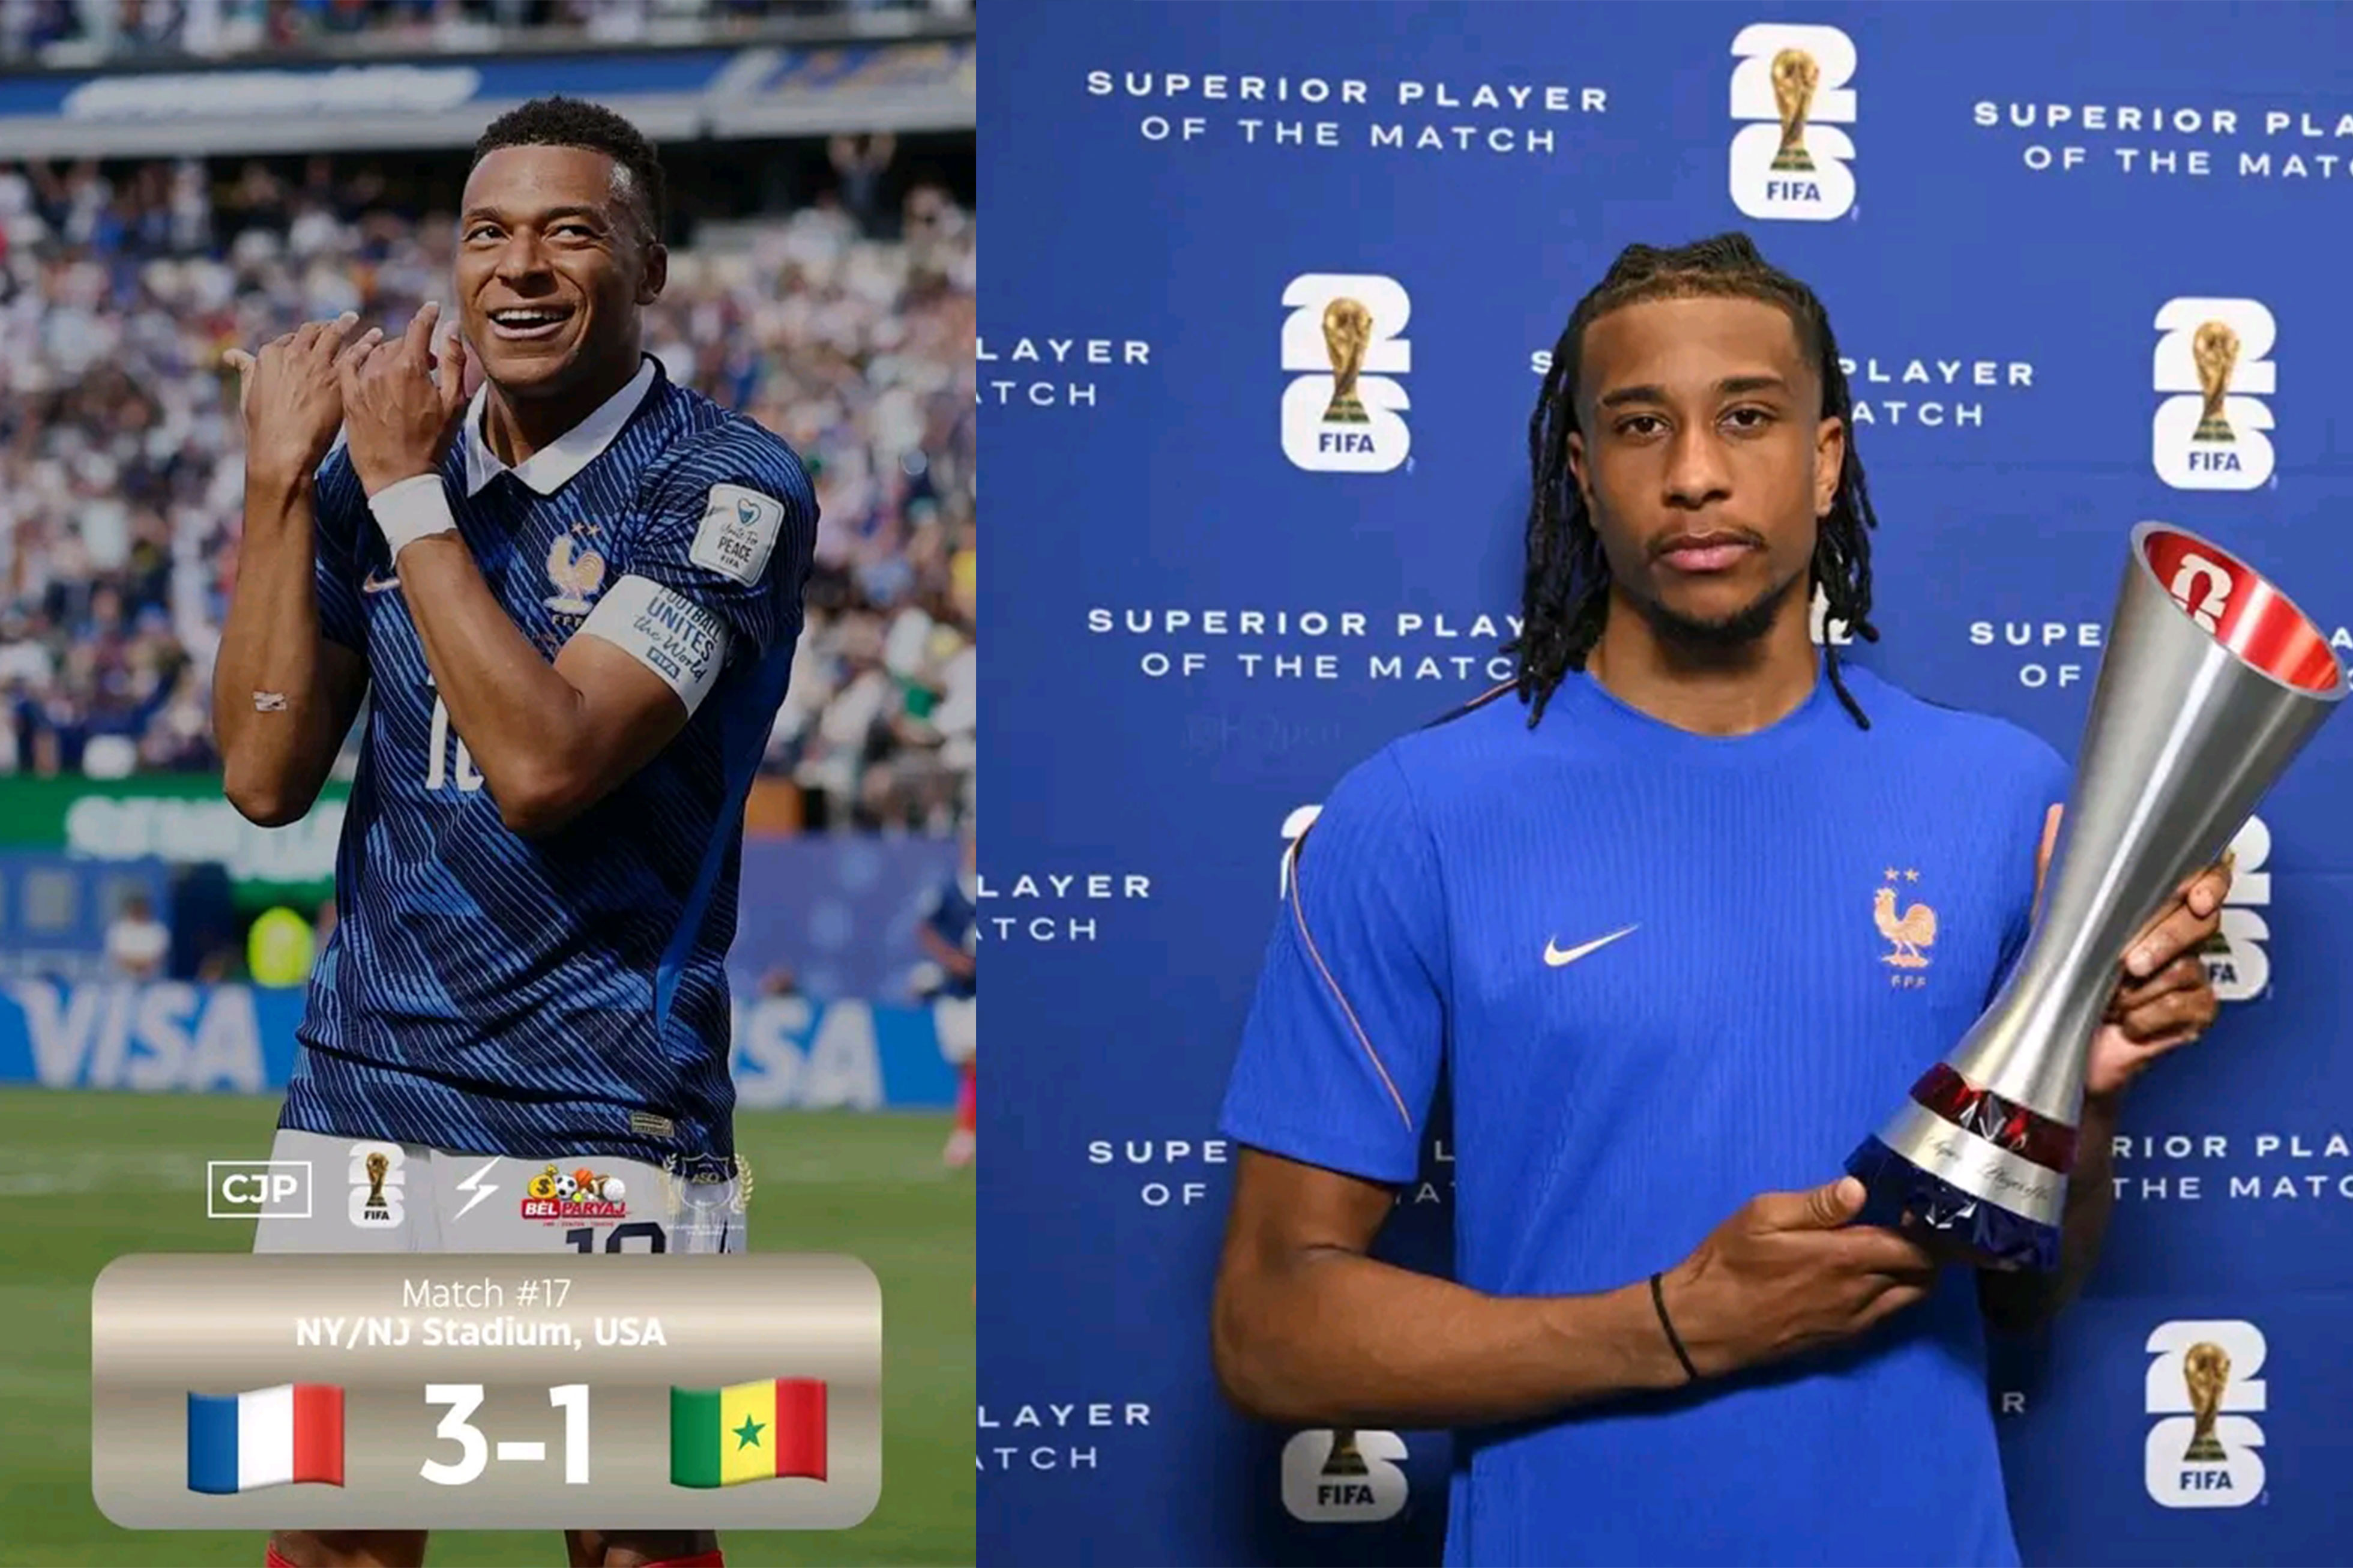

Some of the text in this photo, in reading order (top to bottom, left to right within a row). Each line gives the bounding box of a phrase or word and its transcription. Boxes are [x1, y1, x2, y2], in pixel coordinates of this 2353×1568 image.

[1088, 71, 1607, 112] SUPERIOR PLAYER
[1974, 101, 2353, 137] SUPERIOR PLA
[1141, 116, 1554, 153] OF THE MATCH
[2024, 146, 2353, 178] OF THE MAT
[1766, 181, 1821, 202] FIFA
[976, 337, 1150, 364] LAYER
[976, 381, 1096, 406] TCH
[1852, 400, 1982, 427] ATCH
[1319, 432, 1375, 454] FIFA
[2188, 451, 2241, 472] FIFA
[717, 535, 753, 563] PEACE
[646, 596, 715, 662] UNITES
[1089, 609, 1524, 638] SUPERIOR PLAY
[1970, 622, 2101, 647] SUPE
[663, 635, 708, 684] World
[1141, 653, 1513, 680] OF THE MATC
[2020, 664, 2081, 687] OF
[976, 875, 1150, 898] LAYER
[976, 917, 1096, 941] TCH
[2209, 963, 2238, 983] FA
[8, 978, 265, 1090] VISA
[730, 997, 884, 1111] SA
[1088, 1141, 1227, 1163] SUPE
[2111, 1134, 2351, 1159] RIOR PLA
[1142, 1183, 1206, 1206] OF
[2112, 1174, 2353, 1199] THE MATC
[978, 1404, 1150, 1427] LAYER
[976, 1446, 1097, 1470] TCH
[2180, 1471, 2234, 1491] FIFA
[1318, 1485, 1375, 1505] FIFA
